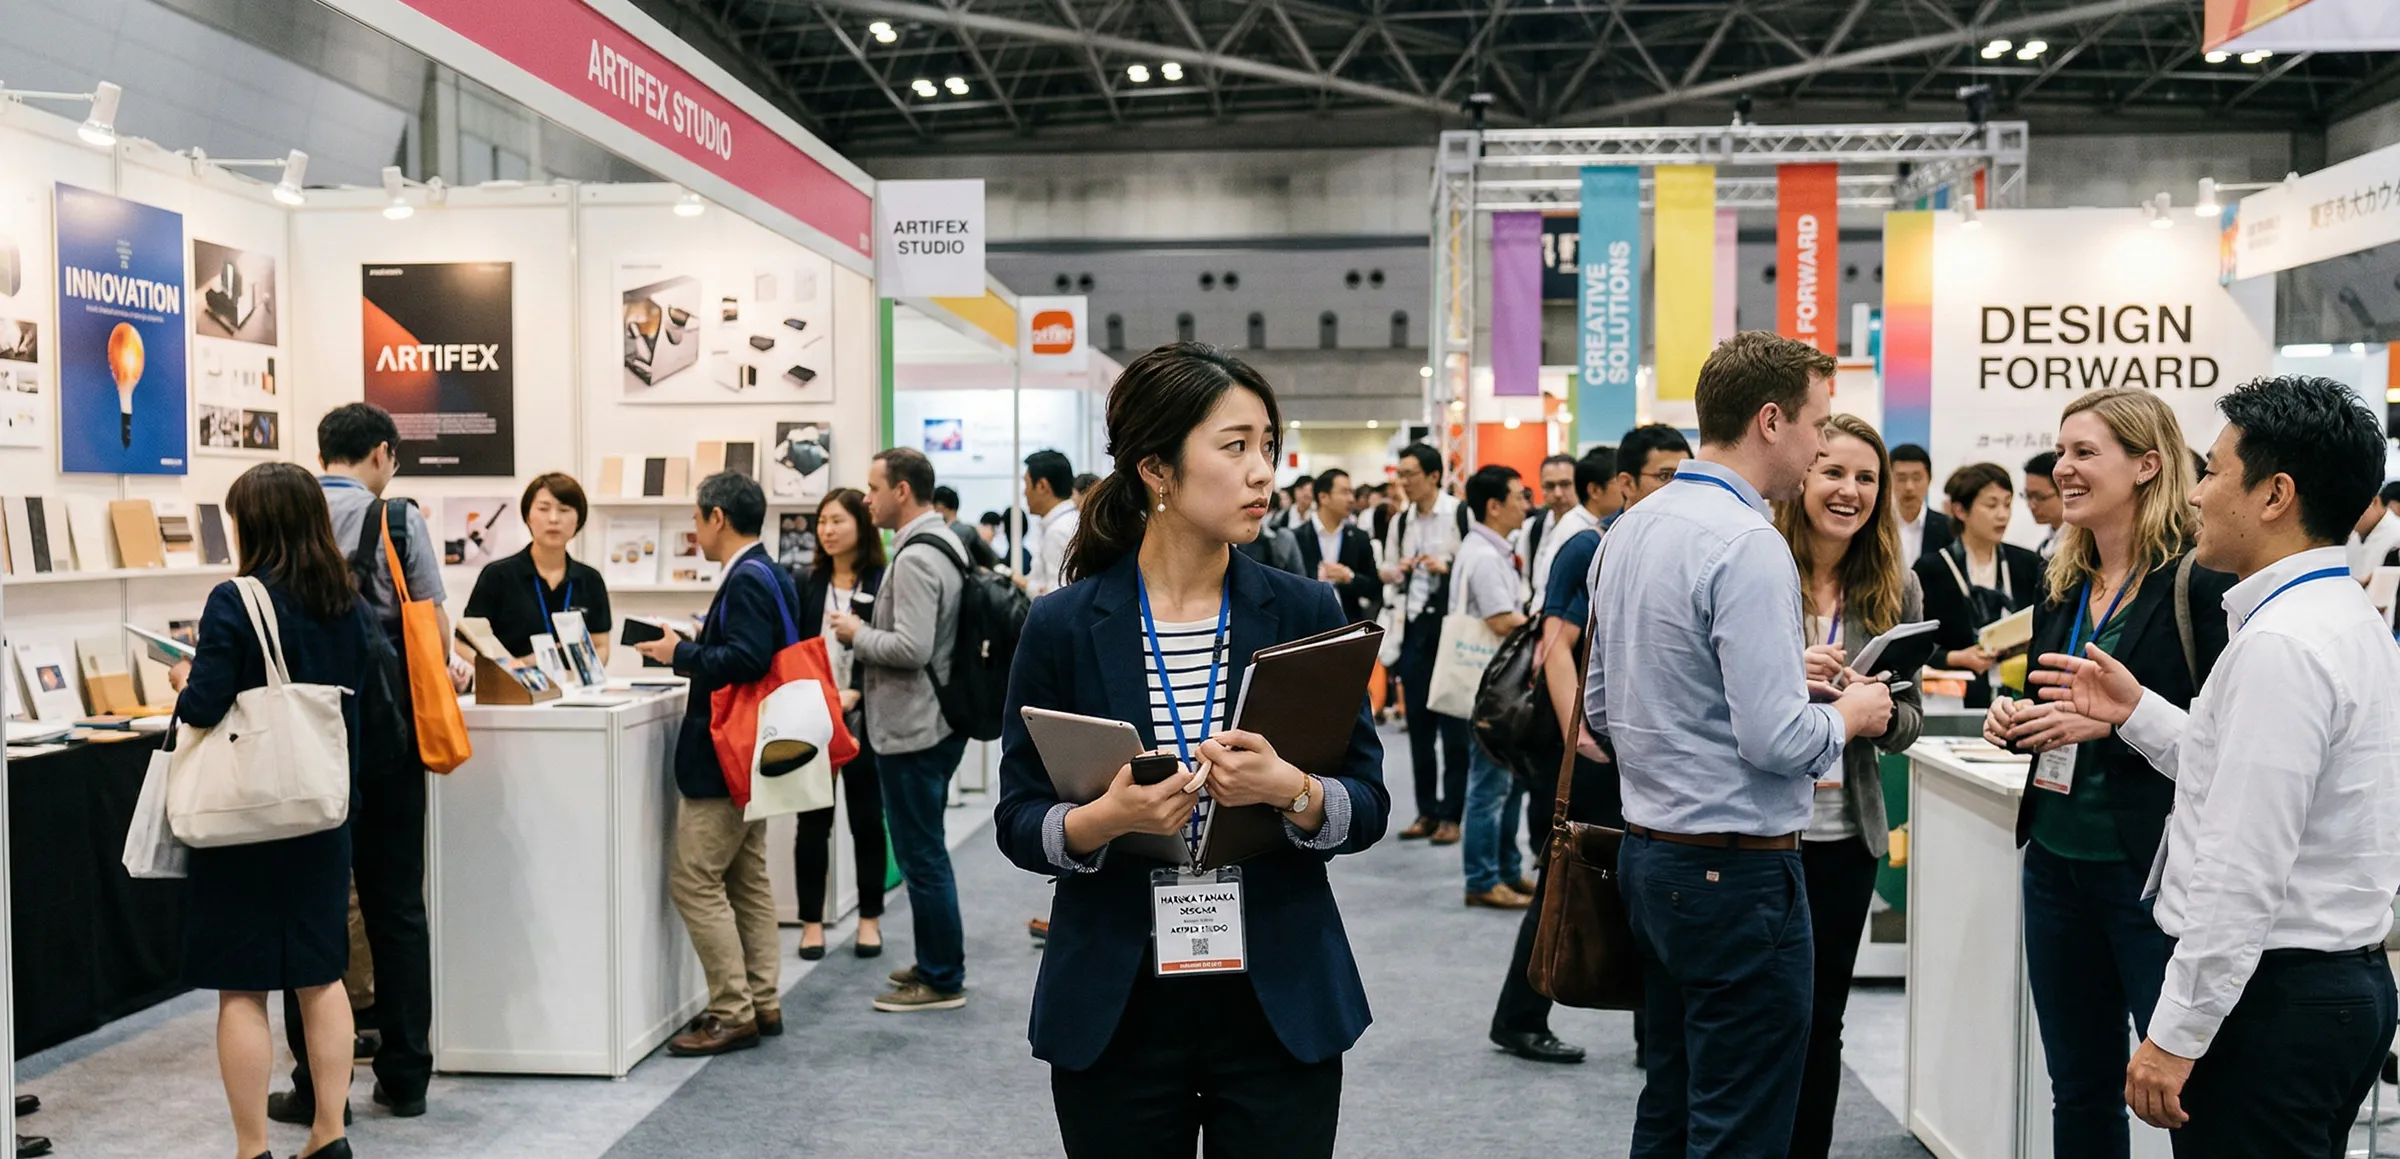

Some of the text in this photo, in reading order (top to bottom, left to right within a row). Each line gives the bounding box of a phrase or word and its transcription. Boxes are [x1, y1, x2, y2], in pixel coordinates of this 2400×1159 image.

[587, 37, 732, 161] ARTIFEX STUDIO
[893, 219, 970, 235] ARTIFEX
[897, 239, 965, 255] STUDIO
[65, 265, 180, 315] INNOVATION
[1796, 213, 1819, 334] FORWARD
[1584, 262, 1607, 386] CREATIVE
[1607, 240, 1631, 385] SOLUTIONS
[1981, 304, 2192, 345] DESIGN
[375, 343, 500, 373] ARTIFEX
[1979, 356, 2219, 390] FORWARD
